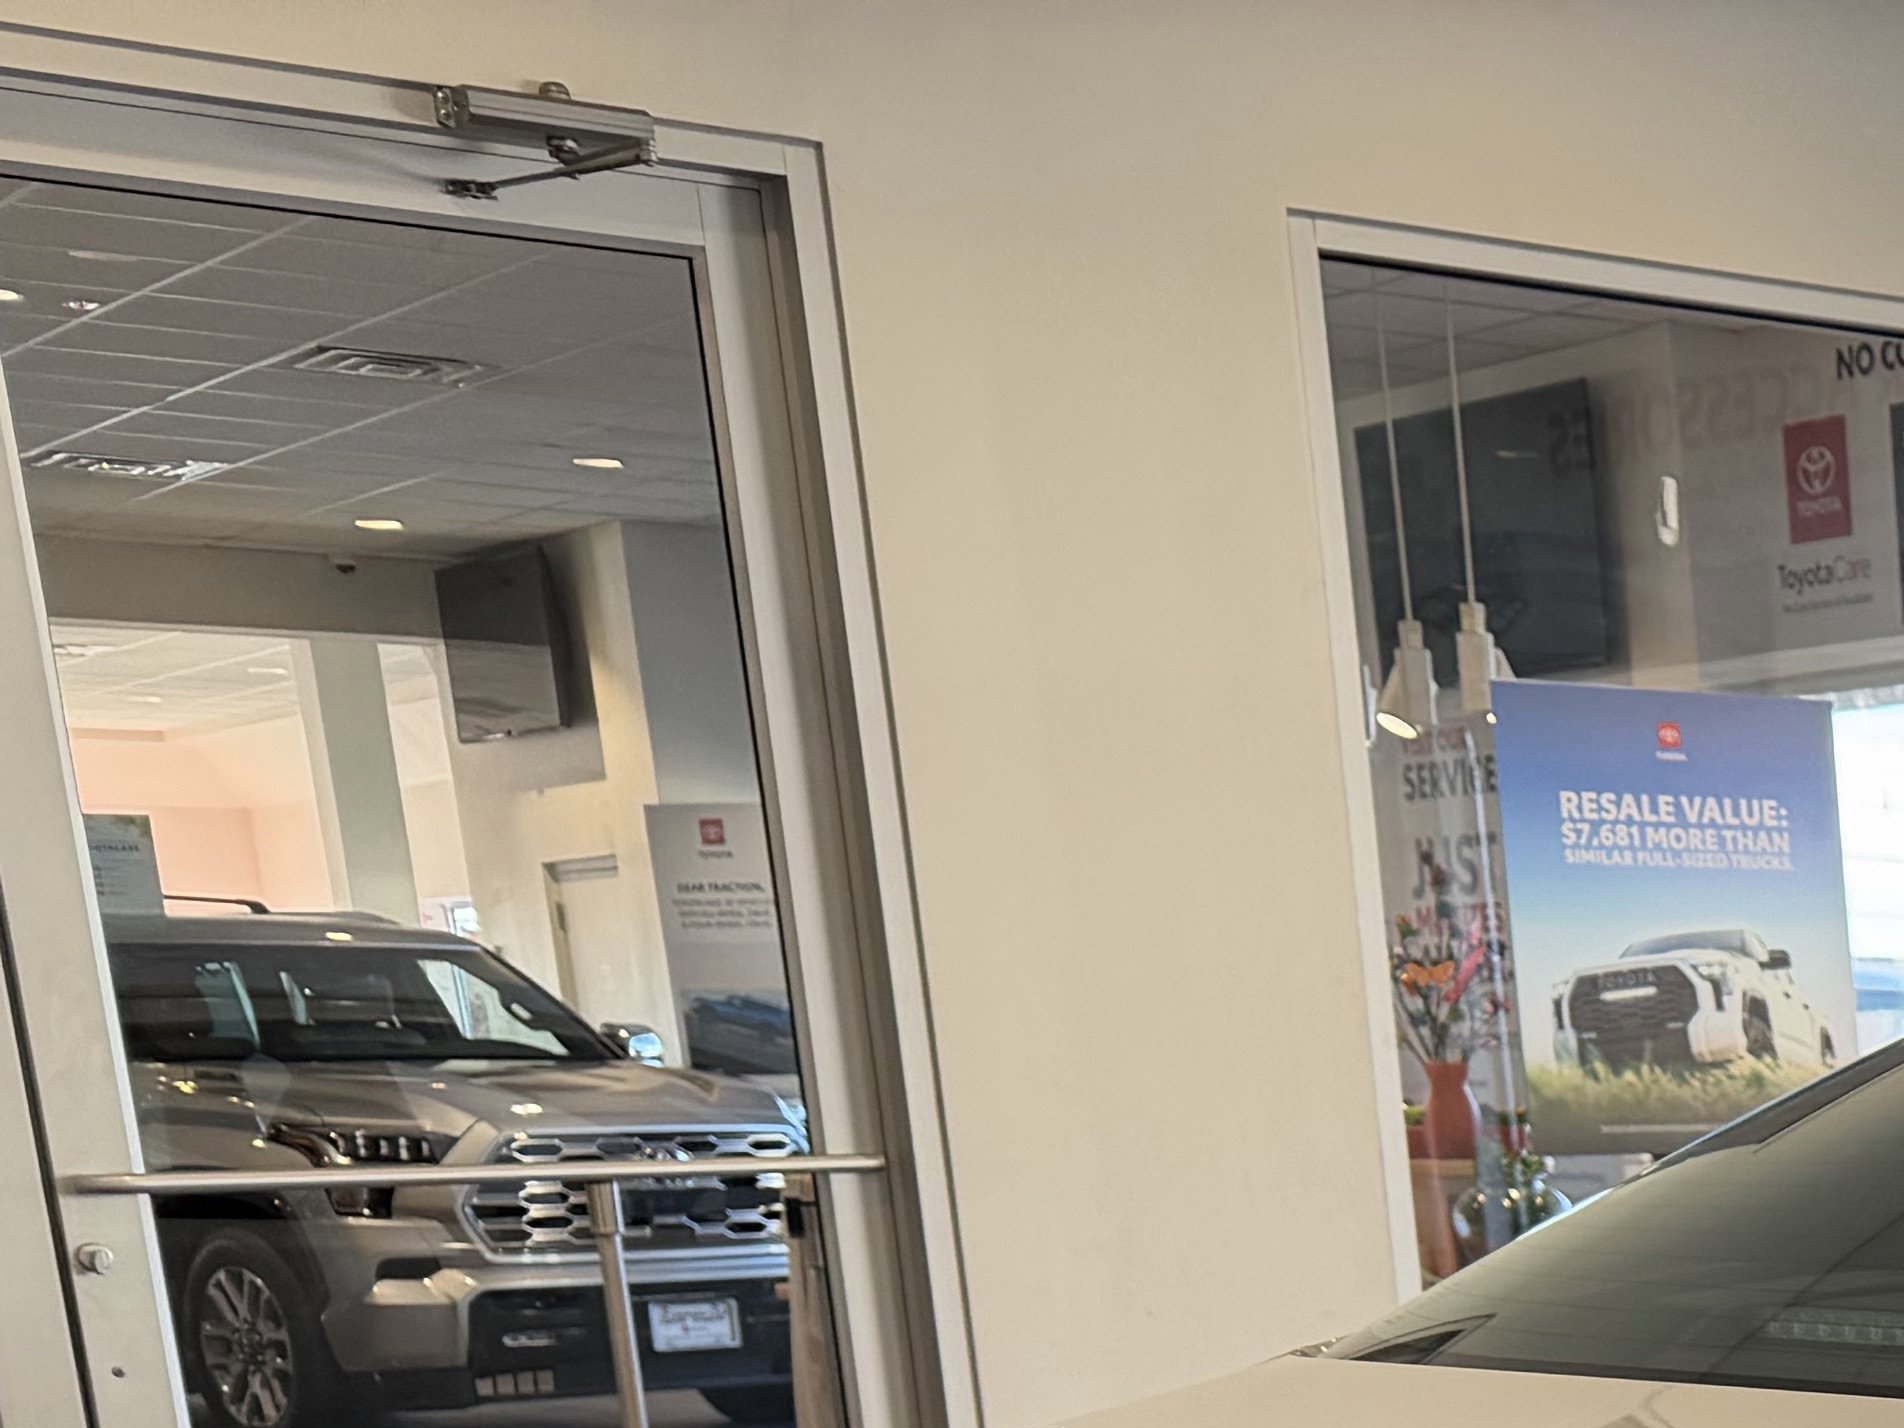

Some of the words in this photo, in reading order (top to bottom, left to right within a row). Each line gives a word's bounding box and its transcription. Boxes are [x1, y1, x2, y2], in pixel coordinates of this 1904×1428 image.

[1836, 342, 1875, 380] NO
[1559, 790, 1677, 824] RESALE
[1680, 795, 1790, 828] VALUE:
[1645, 826, 1719, 850] MORE
[1721, 829, 1791, 854] THAN
[1564, 849, 1634, 867] SIMILAR
[1636, 851, 1728, 868] FULL-SIZED
